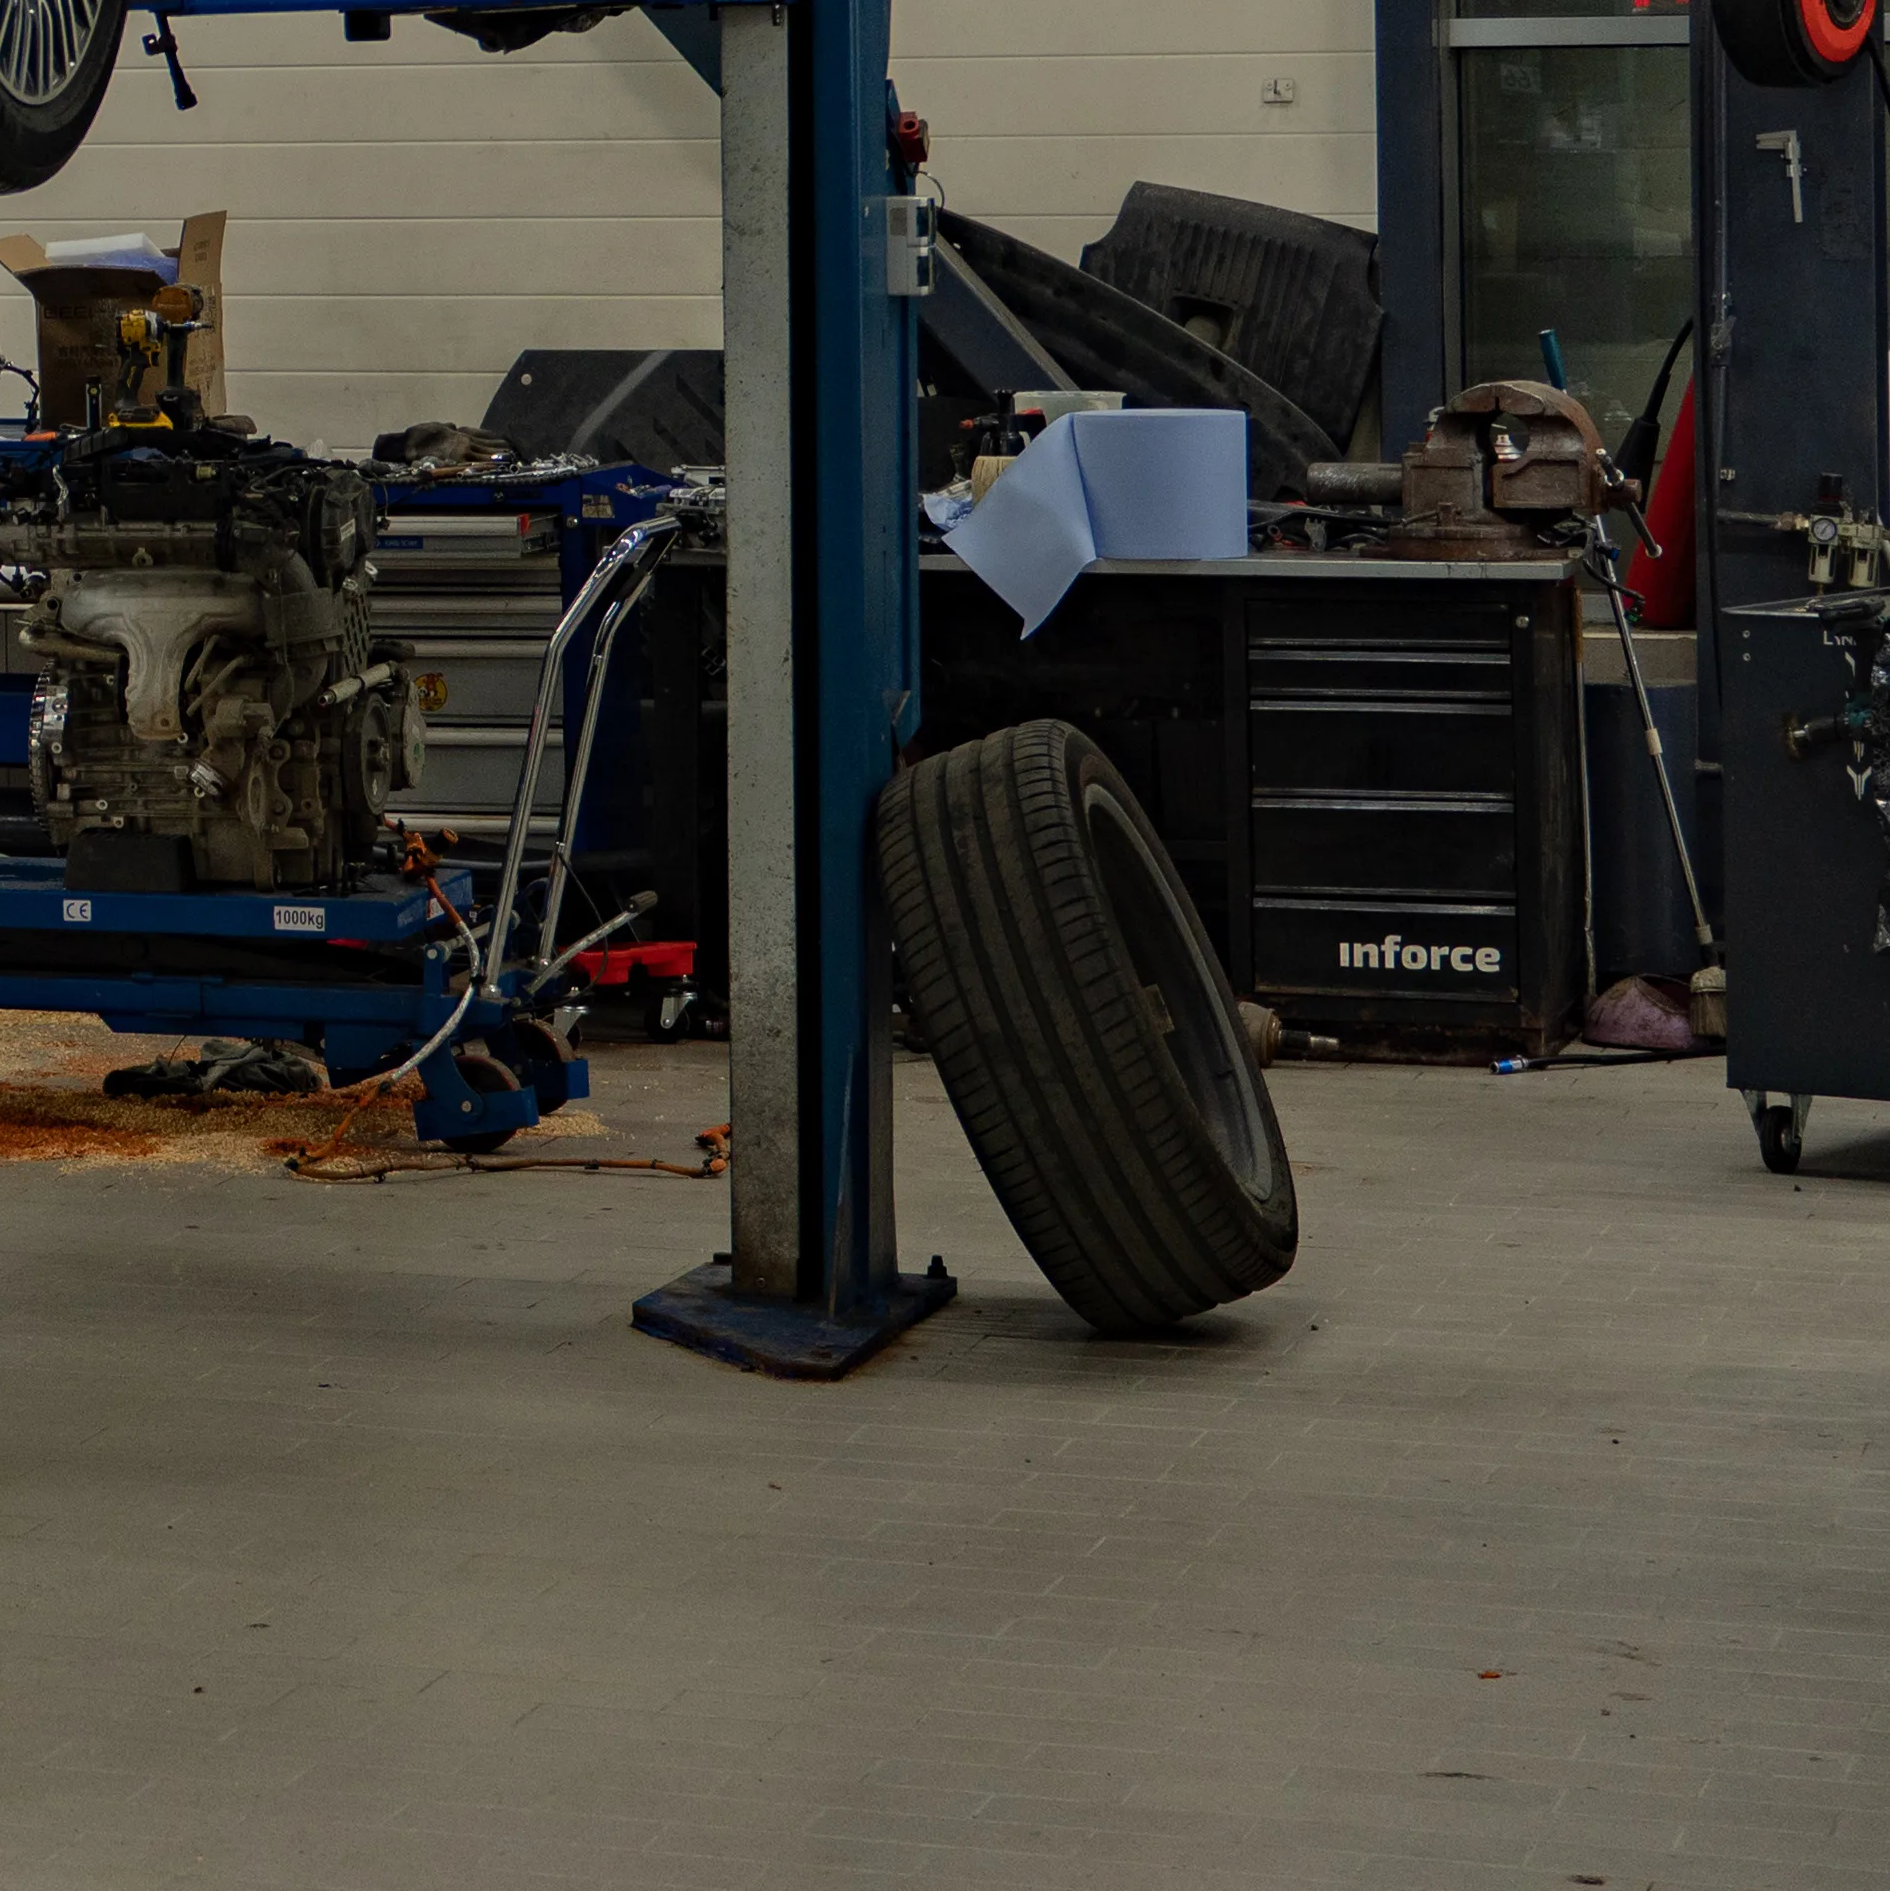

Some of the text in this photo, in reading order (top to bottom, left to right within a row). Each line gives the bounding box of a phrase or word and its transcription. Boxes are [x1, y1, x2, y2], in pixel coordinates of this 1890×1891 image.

[1823, 630, 1858, 646] LYN
[276, 909, 325, 930] 1000kg
[1339, 934, 1501, 973] inforce
